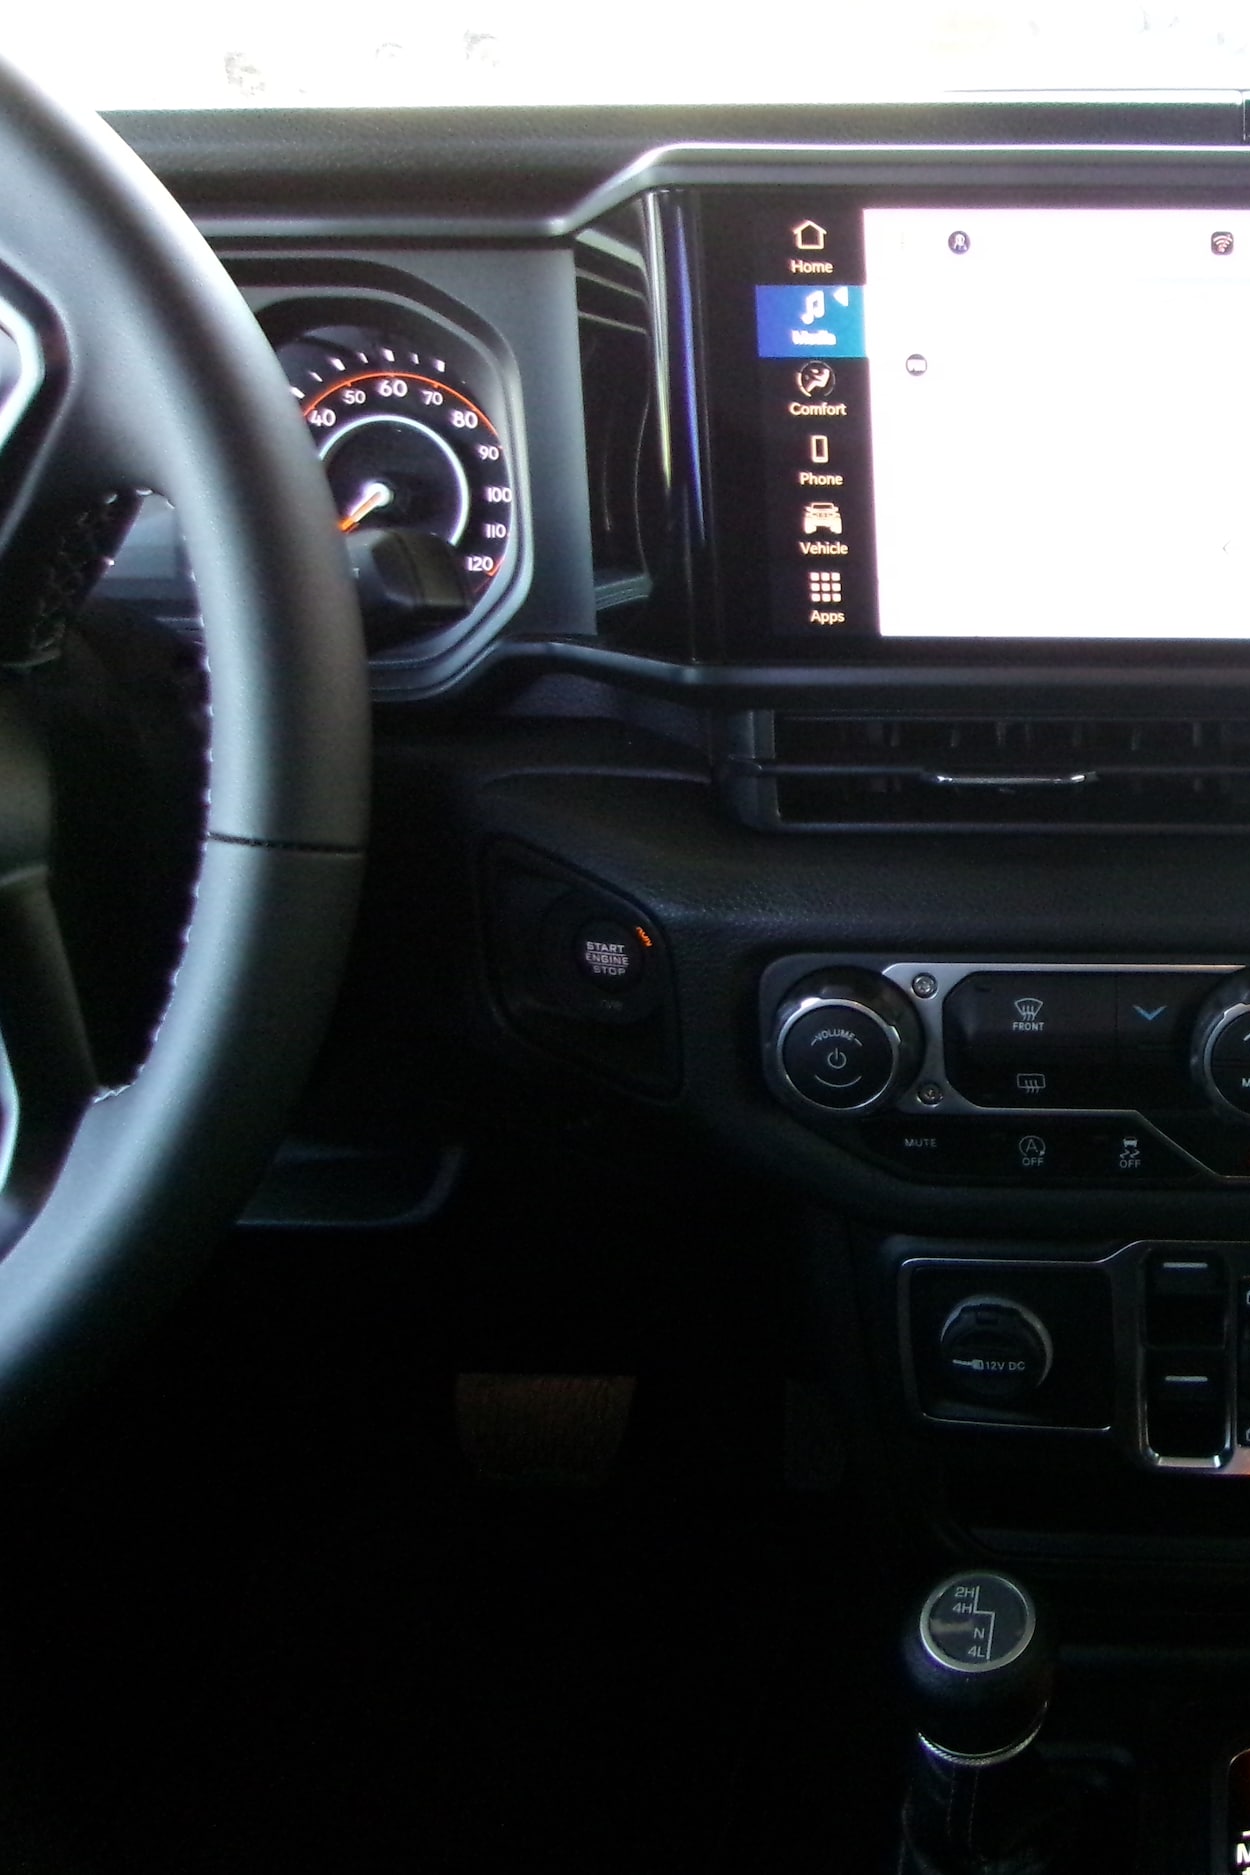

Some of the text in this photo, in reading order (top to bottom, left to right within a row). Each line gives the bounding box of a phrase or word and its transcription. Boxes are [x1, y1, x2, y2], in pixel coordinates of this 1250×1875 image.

[791, 259, 833, 274] Home
[379, 380, 408, 397] 60
[345, 390, 366, 405] 50
[425, 391, 444, 406] 70
[790, 401, 847, 416] Comfort
[309, 409, 336, 427] 40
[452, 412, 478, 429] 80
[480, 445, 500, 461] 90
[799, 472, 844, 486] Phone
[488, 487, 512, 503] 100
[486, 524, 507, 539] 110
[800, 541, 849, 556] Vehicle
[468, 555, 494, 572] 120
[810, 609, 845, 625] Apps
[586, 941, 625, 952] START
[585, 953, 630, 966] ENGINE
[593, 966, 626, 976] STOP
[1012, 1021, 1045, 1032] FRONT
[815, 1028, 856, 1041] VOLUME
[904, 1138, 937, 1149] MUTE
[1022, 1156, 1045, 1168] OFF
[1119, 1159, 1142, 1170] OFF
[986, 1358, 1026, 1372] 12V DC
[954, 1585, 976, 1598] 2H
[952, 1601, 973, 1614] 4H
[973, 1627, 985, 1639] N
[967, 1645, 985, 1658] 4L
